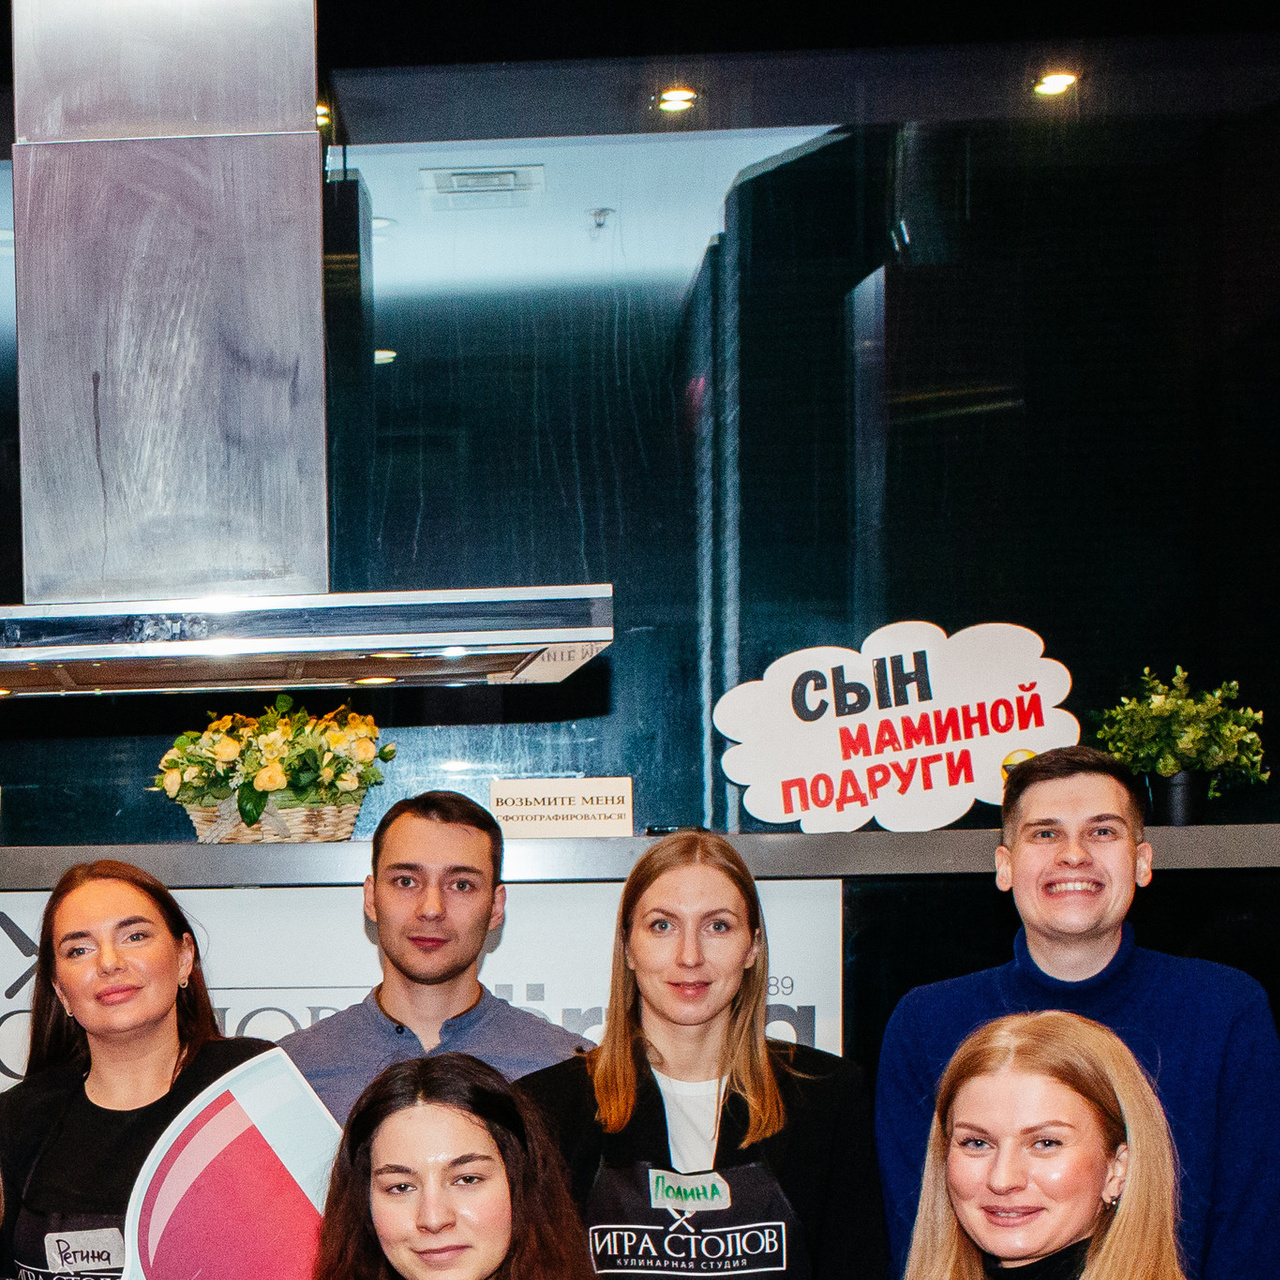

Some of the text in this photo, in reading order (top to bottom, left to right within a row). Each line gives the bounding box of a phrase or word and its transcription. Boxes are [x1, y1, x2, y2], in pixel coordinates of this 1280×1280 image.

[791, 650, 933, 723] СЫН
[839, 681, 1045, 761] МАМИНОЙ
[781, 748, 975, 815] ПОДРУГИ
[495, 795, 626, 807] ВОЗЬМИТЕ МЕНЯ
[766, 975, 795, 996] 89
[55, 1239, 112, 1267] Регина
[594, 1229, 779, 1259] ИГРА СТОЛОВ
[616, 1258, 747, 1270] КУЛИНАРНАЯ СТУДИЯ
